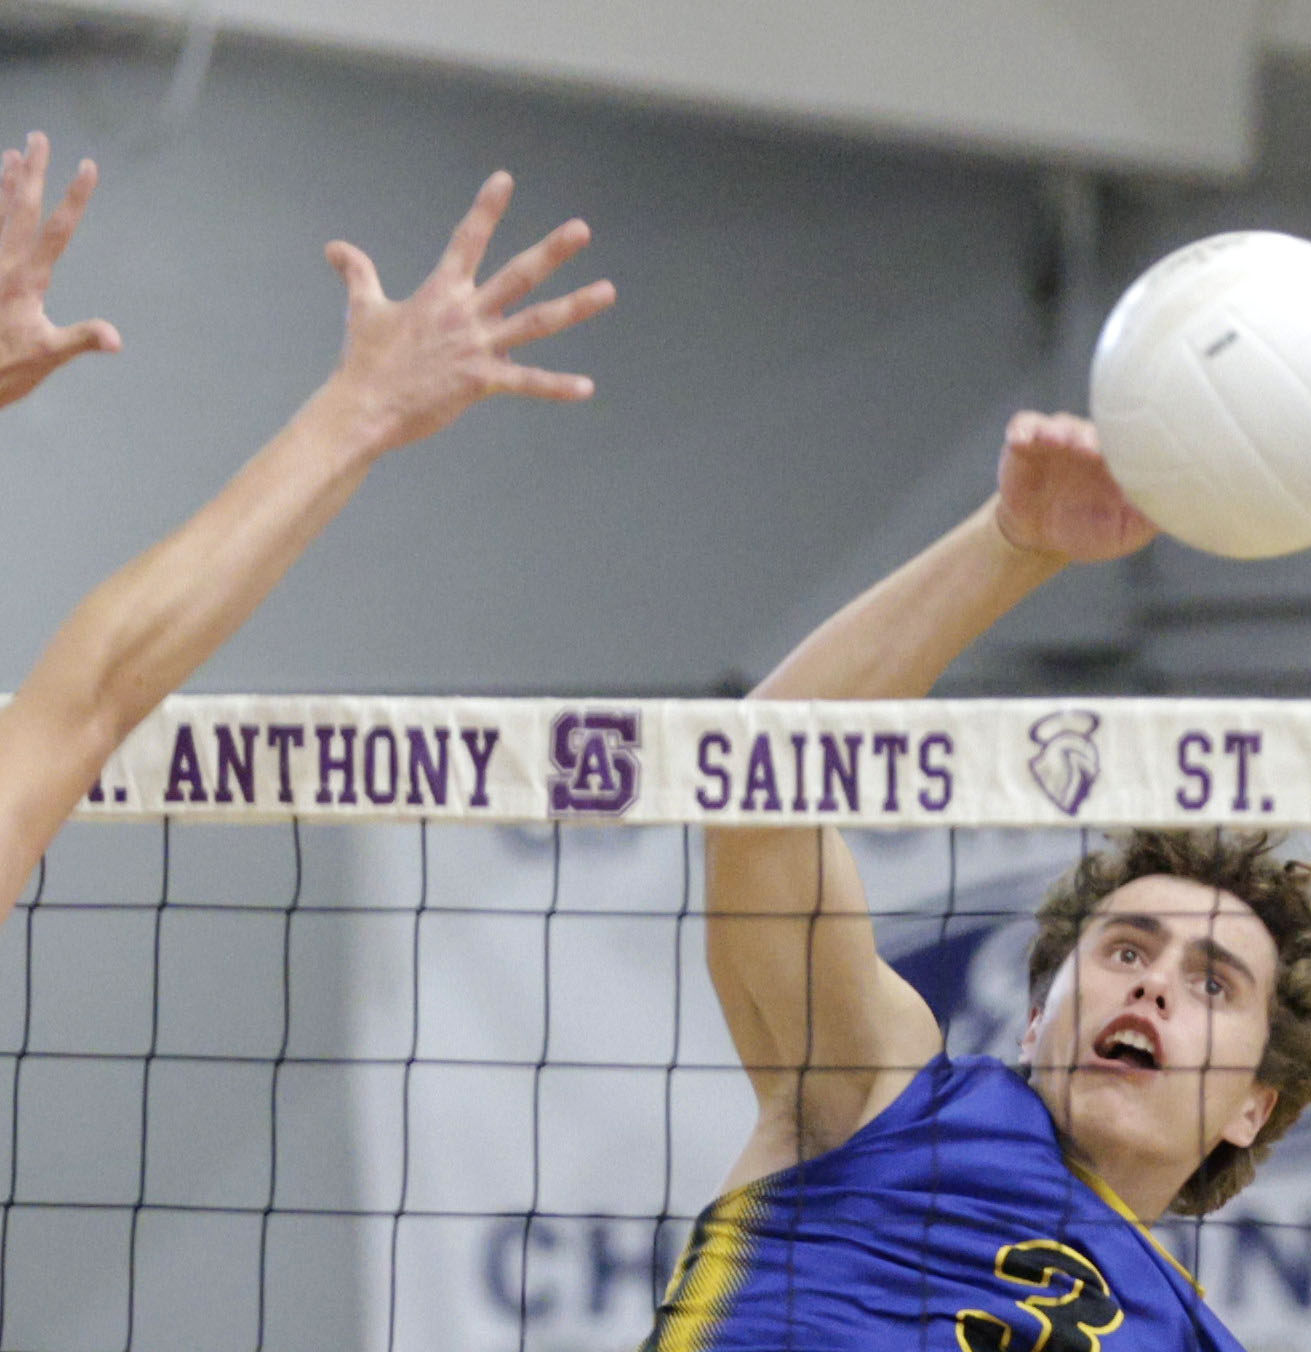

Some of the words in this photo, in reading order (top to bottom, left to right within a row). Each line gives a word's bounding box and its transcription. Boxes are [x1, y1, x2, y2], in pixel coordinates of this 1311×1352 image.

[163, 724, 500, 807] ANTHONY
[696, 732, 954, 812] SAINTS
[1176, 732, 1273, 812] ST.
